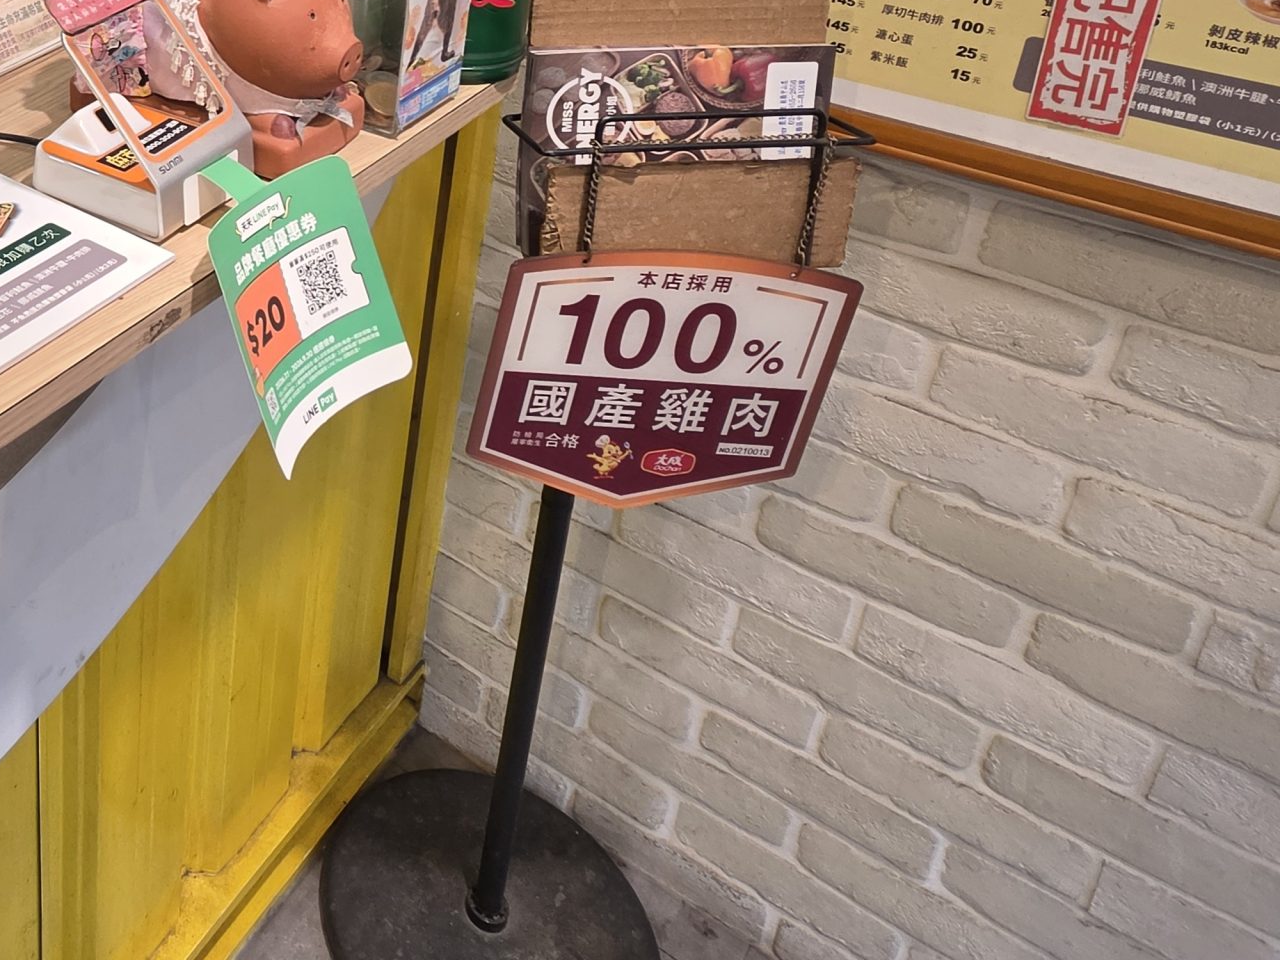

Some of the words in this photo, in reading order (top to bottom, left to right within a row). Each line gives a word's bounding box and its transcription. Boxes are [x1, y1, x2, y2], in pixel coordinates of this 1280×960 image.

[881, 4, 945, 26] 厚切牛肉排
[1205, 39, 1250, 55] 183kcal
[561, 100, 574, 133] MISS
[637, 272, 733, 294] 本店採用
[247, 296, 285, 357] $20
[303, 404, 319, 425] LINE
[320, 391, 335, 407] Pay
[518, 379, 779, 438] 國產雞肉
[544, 433, 580, 449] 合格
